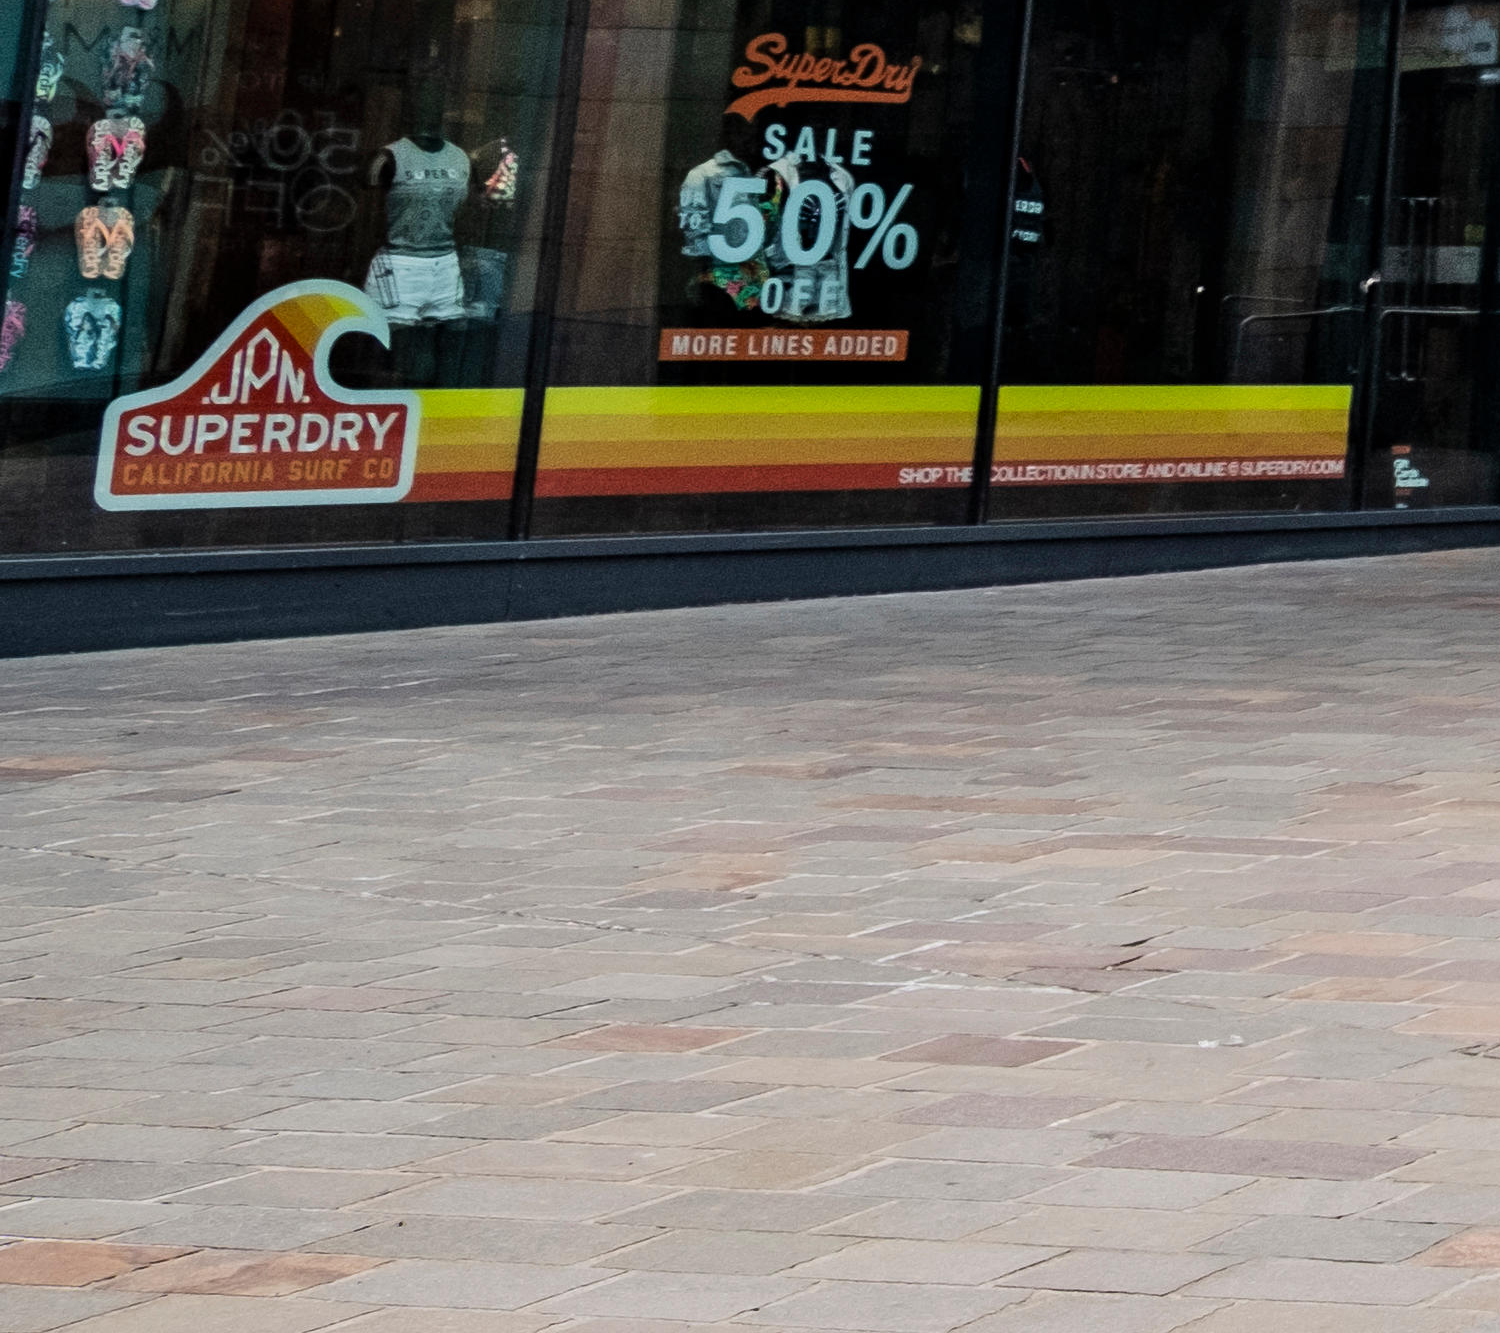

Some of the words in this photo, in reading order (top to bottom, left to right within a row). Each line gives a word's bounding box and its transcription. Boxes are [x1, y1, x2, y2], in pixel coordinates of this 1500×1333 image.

[763, 123, 874, 167] SALE
[708, 177, 920, 270] 50%
[760, 275, 844, 315] OFF
[671, 334, 737, 356] MORE
[746, 335, 814, 356] LINES
[823, 335, 898, 356] ADDED
[123, 411, 400, 457] SUPERDRY
[122, 461, 275, 485] CALIFORNIA
[288, 459, 351, 483] SURF
[362, 458, 395, 480] CO
[899, 467, 943, 484] SHOP
[944, 466, 974, 483] THE
[1080, 464, 1095, 479] IN
[1096, 464, 1144, 479] STORE
[1144, 463, 1176, 478] AND
[1176, 462, 1227, 478] ONLINE
[1240, 459, 1345, 477] SUPERDRY.COM
